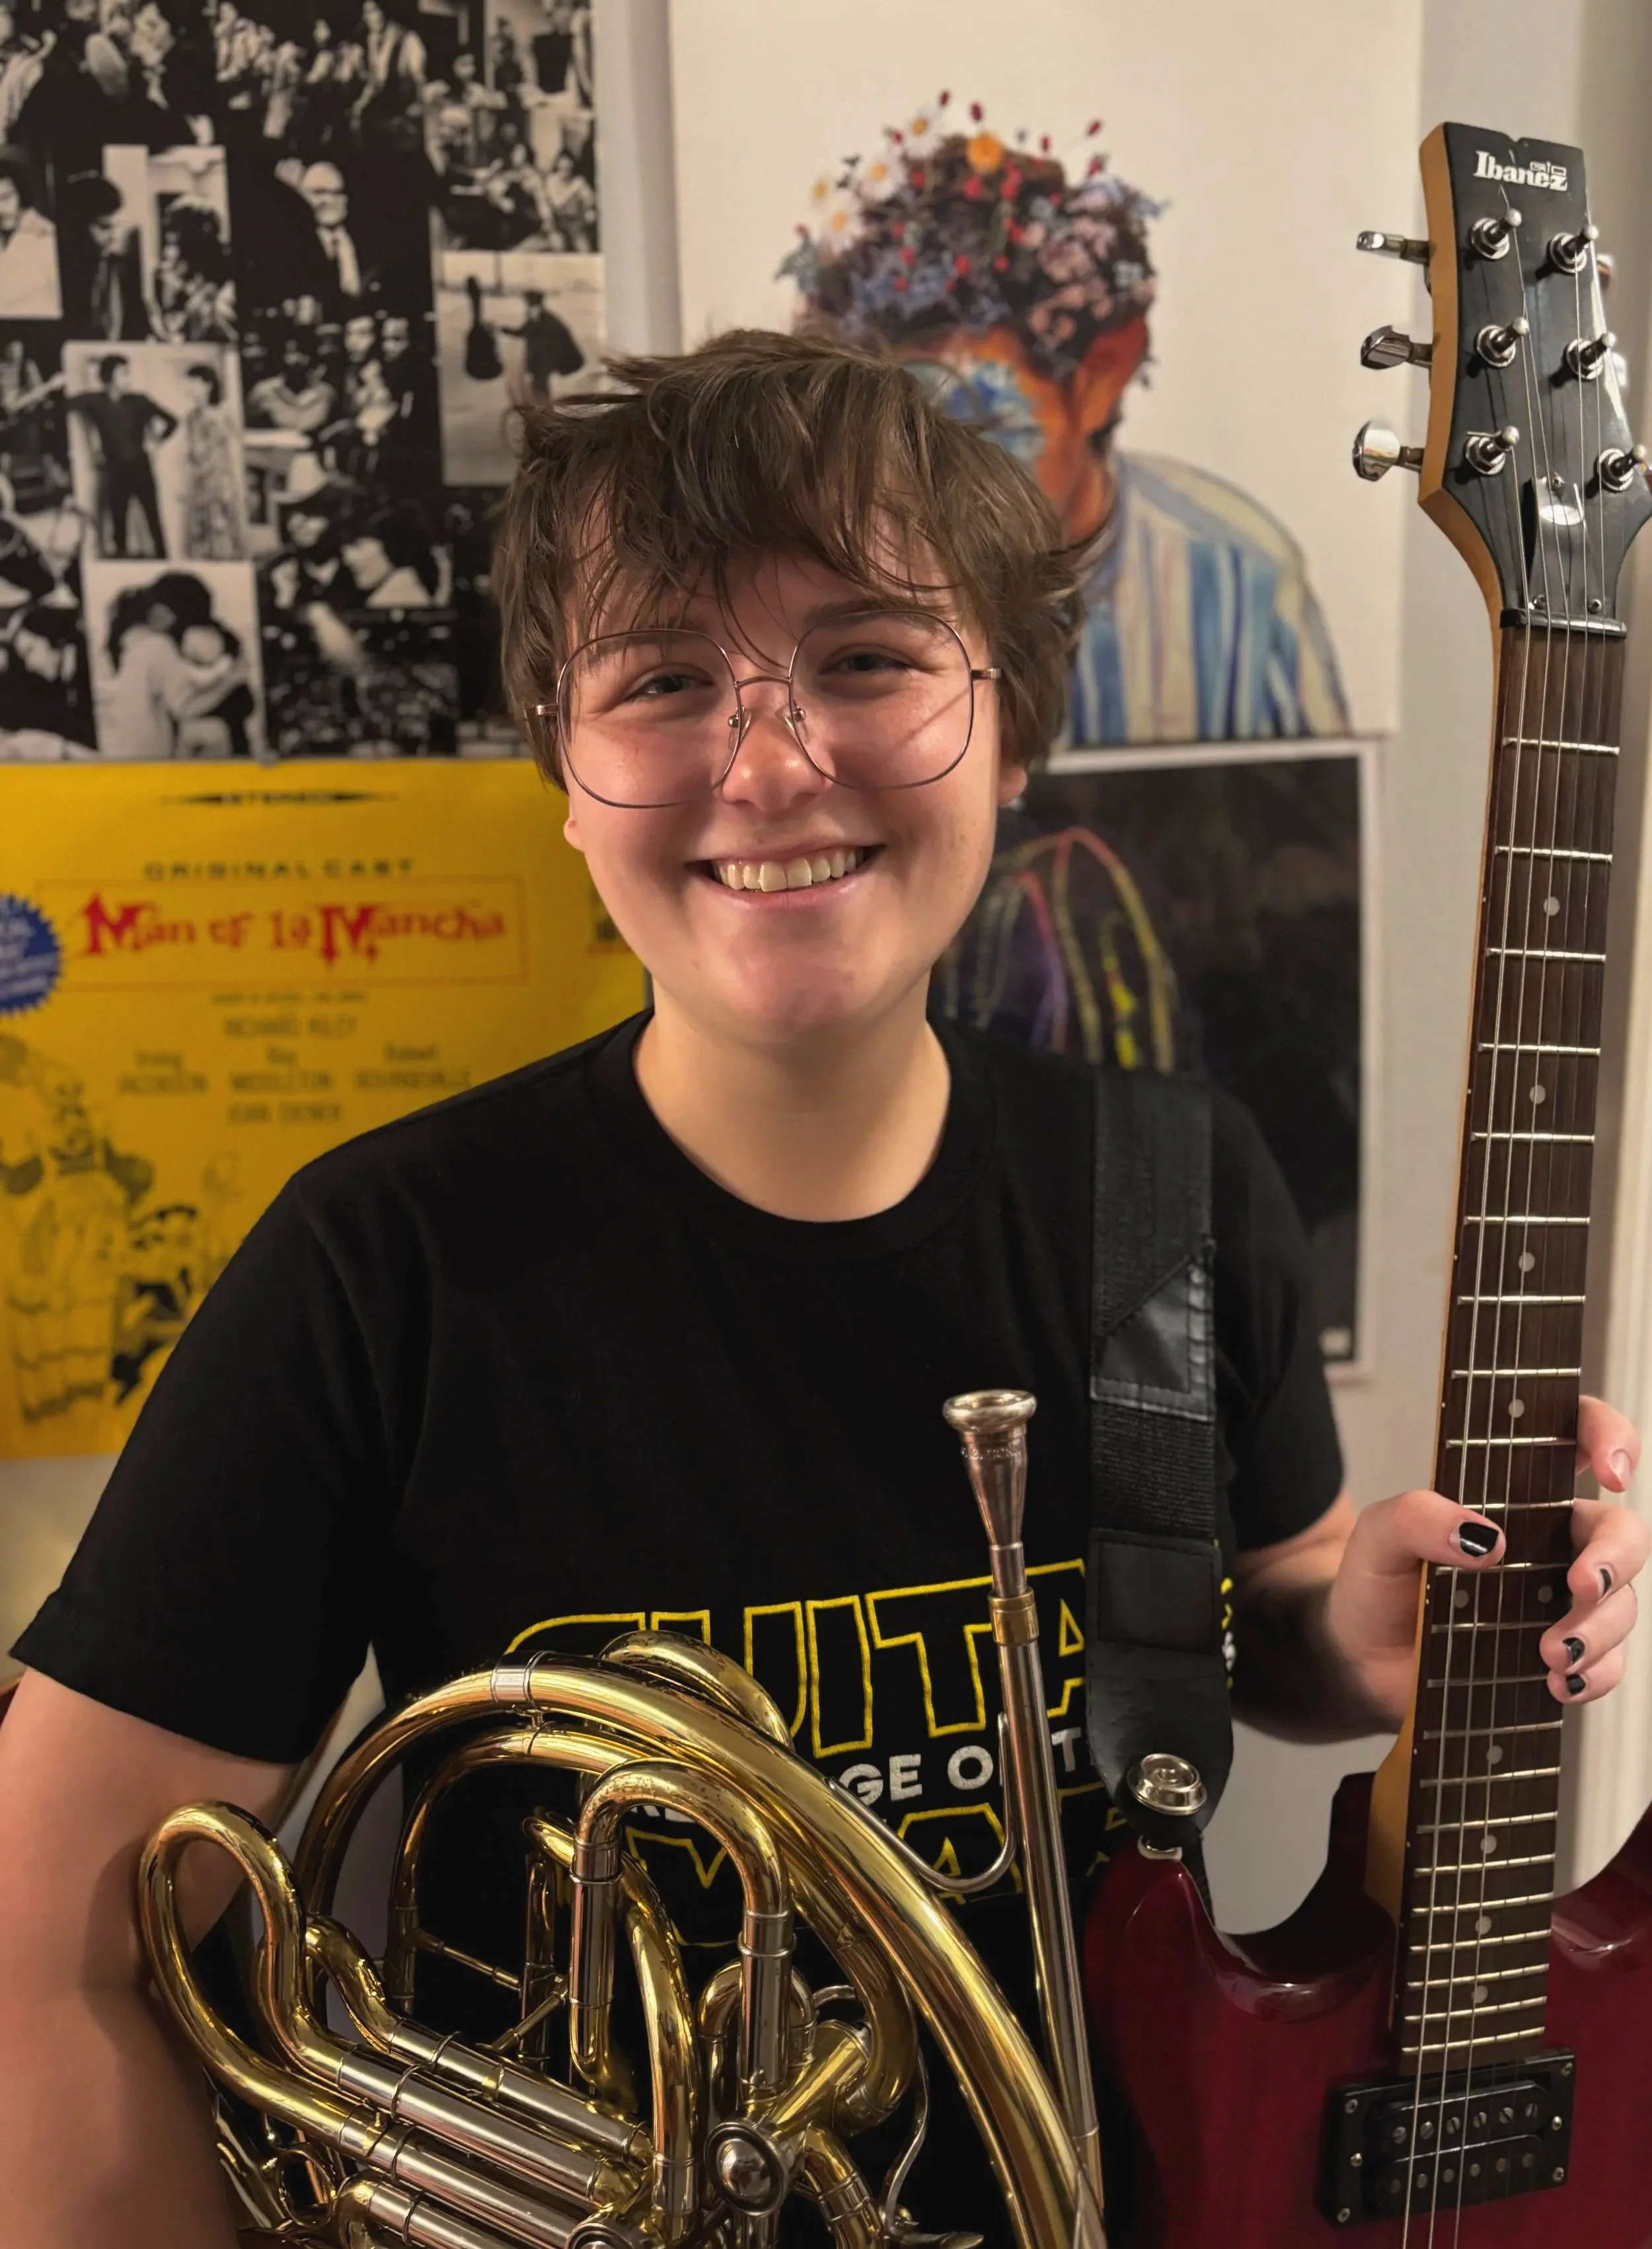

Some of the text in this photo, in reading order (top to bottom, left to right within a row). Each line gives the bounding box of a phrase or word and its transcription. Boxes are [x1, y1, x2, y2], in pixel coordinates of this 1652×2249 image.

[1473, 151, 1568, 192] Ibanez
[143, 857, 414, 880] ORIGINAL CAST
[82, 891, 197, 956] Man
[207, 910, 255, 948] of
[316, 902, 506, 967] Mancha
